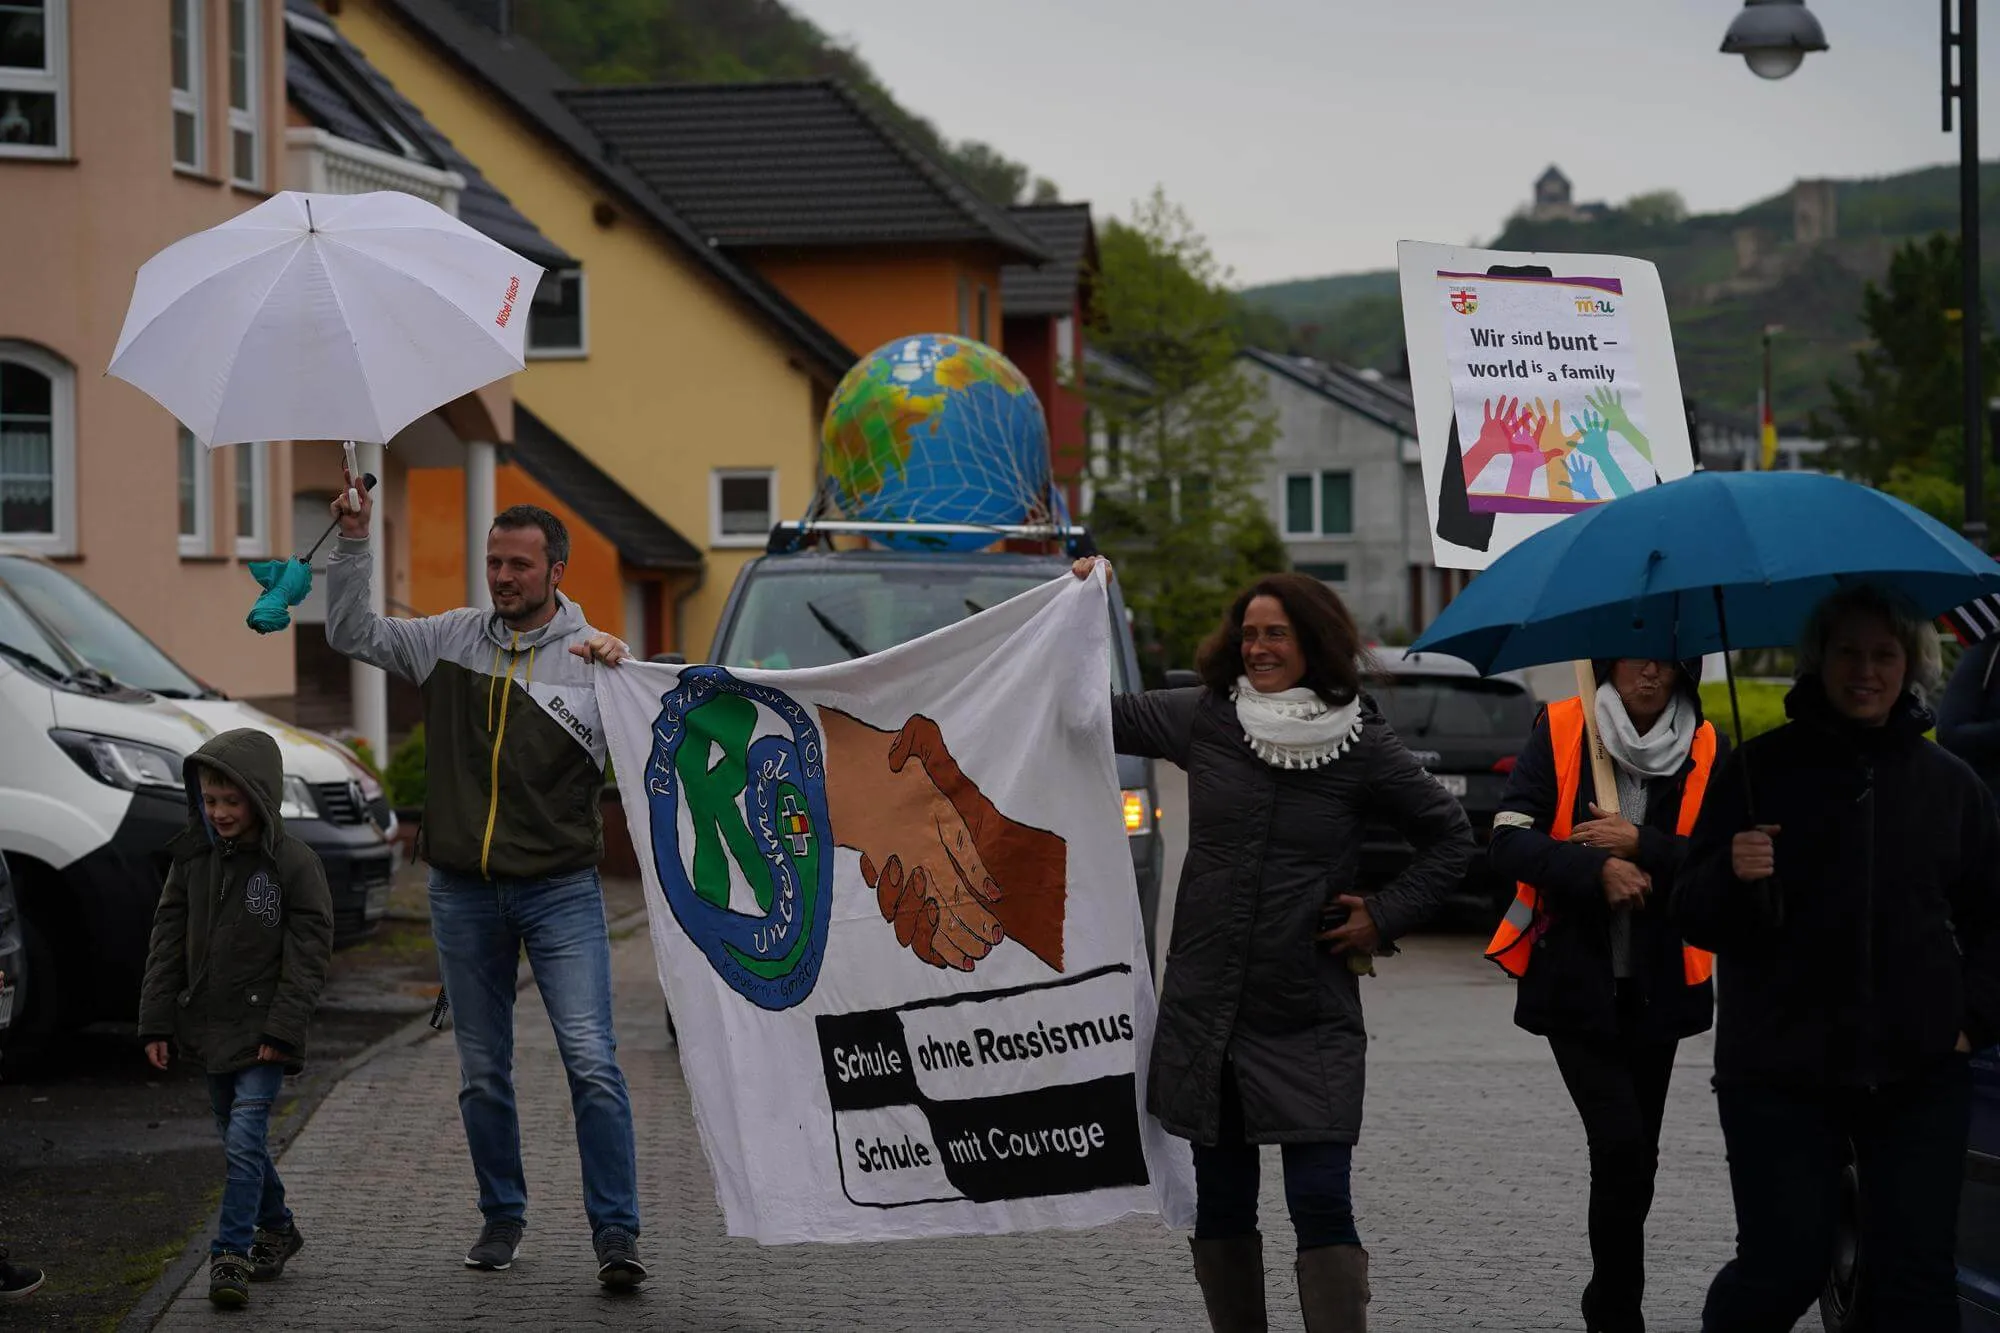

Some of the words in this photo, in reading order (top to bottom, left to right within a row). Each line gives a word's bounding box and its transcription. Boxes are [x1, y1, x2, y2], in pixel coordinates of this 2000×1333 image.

[495, 301, 512, 328] Möbel
[1470, 327, 1505, 348] Wir
[1511, 331, 1543, 347] sind
[1547, 331, 1598, 351] bunt
[1468, 360, 1528, 378] world
[1531, 360, 1542, 374] is
[1547, 370, 1557, 382] a
[1560, 364, 1615, 384] family
[801, 726, 821, 780] FOS
[245, 871, 281, 928] 93
[834, 1041, 902, 1083] Schule
[917, 1035, 973, 1072] ohne
[973, 1013, 1134, 1065] Rassismus
[855, 1134, 932, 1173] Schule
[949, 1126, 987, 1164] mit
[987, 1121, 1105, 1158] Courage
